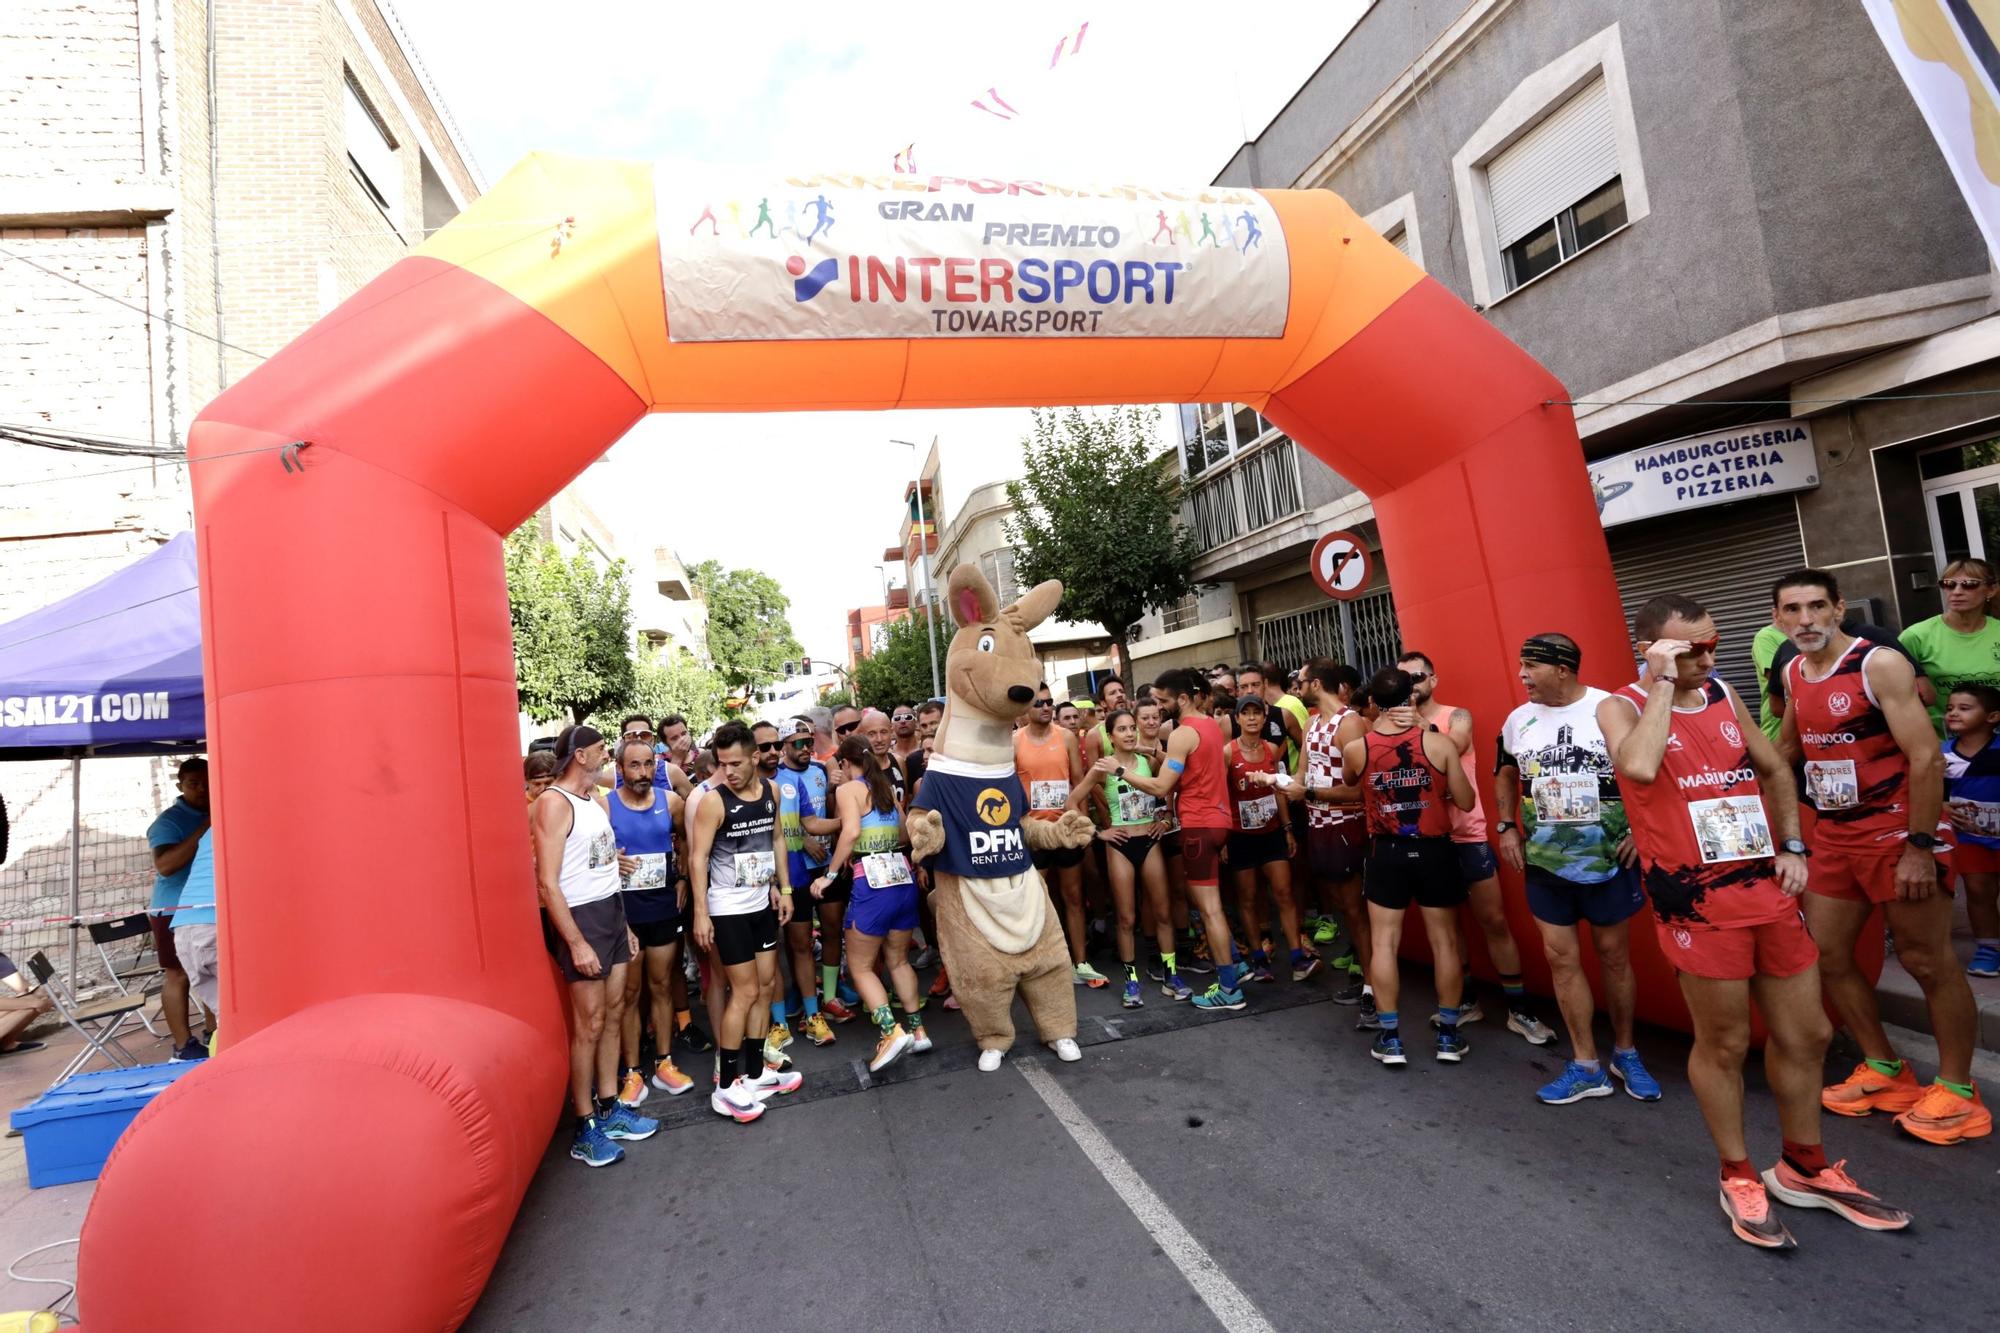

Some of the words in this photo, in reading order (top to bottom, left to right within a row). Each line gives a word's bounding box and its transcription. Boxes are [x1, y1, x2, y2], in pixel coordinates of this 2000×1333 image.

[878, 201, 974, 222] GRAN
[982, 222, 1120, 249] PREMIO
[849, 254, 1183, 305] INTERSPORT
[933, 309, 1103, 333] TOVARSPORT
[1635, 427, 1807, 473] HAMBURGUESERIA
[1662, 450, 1784, 485] BOCATERIA
[1677, 471, 1774, 500] PIZZERIA
[0, 691, 170, 728] SAL21.COM
[726, 829, 750, 838] PUERTO
[969, 828, 1023, 855] DFM
[971, 855, 998, 865] RENT
